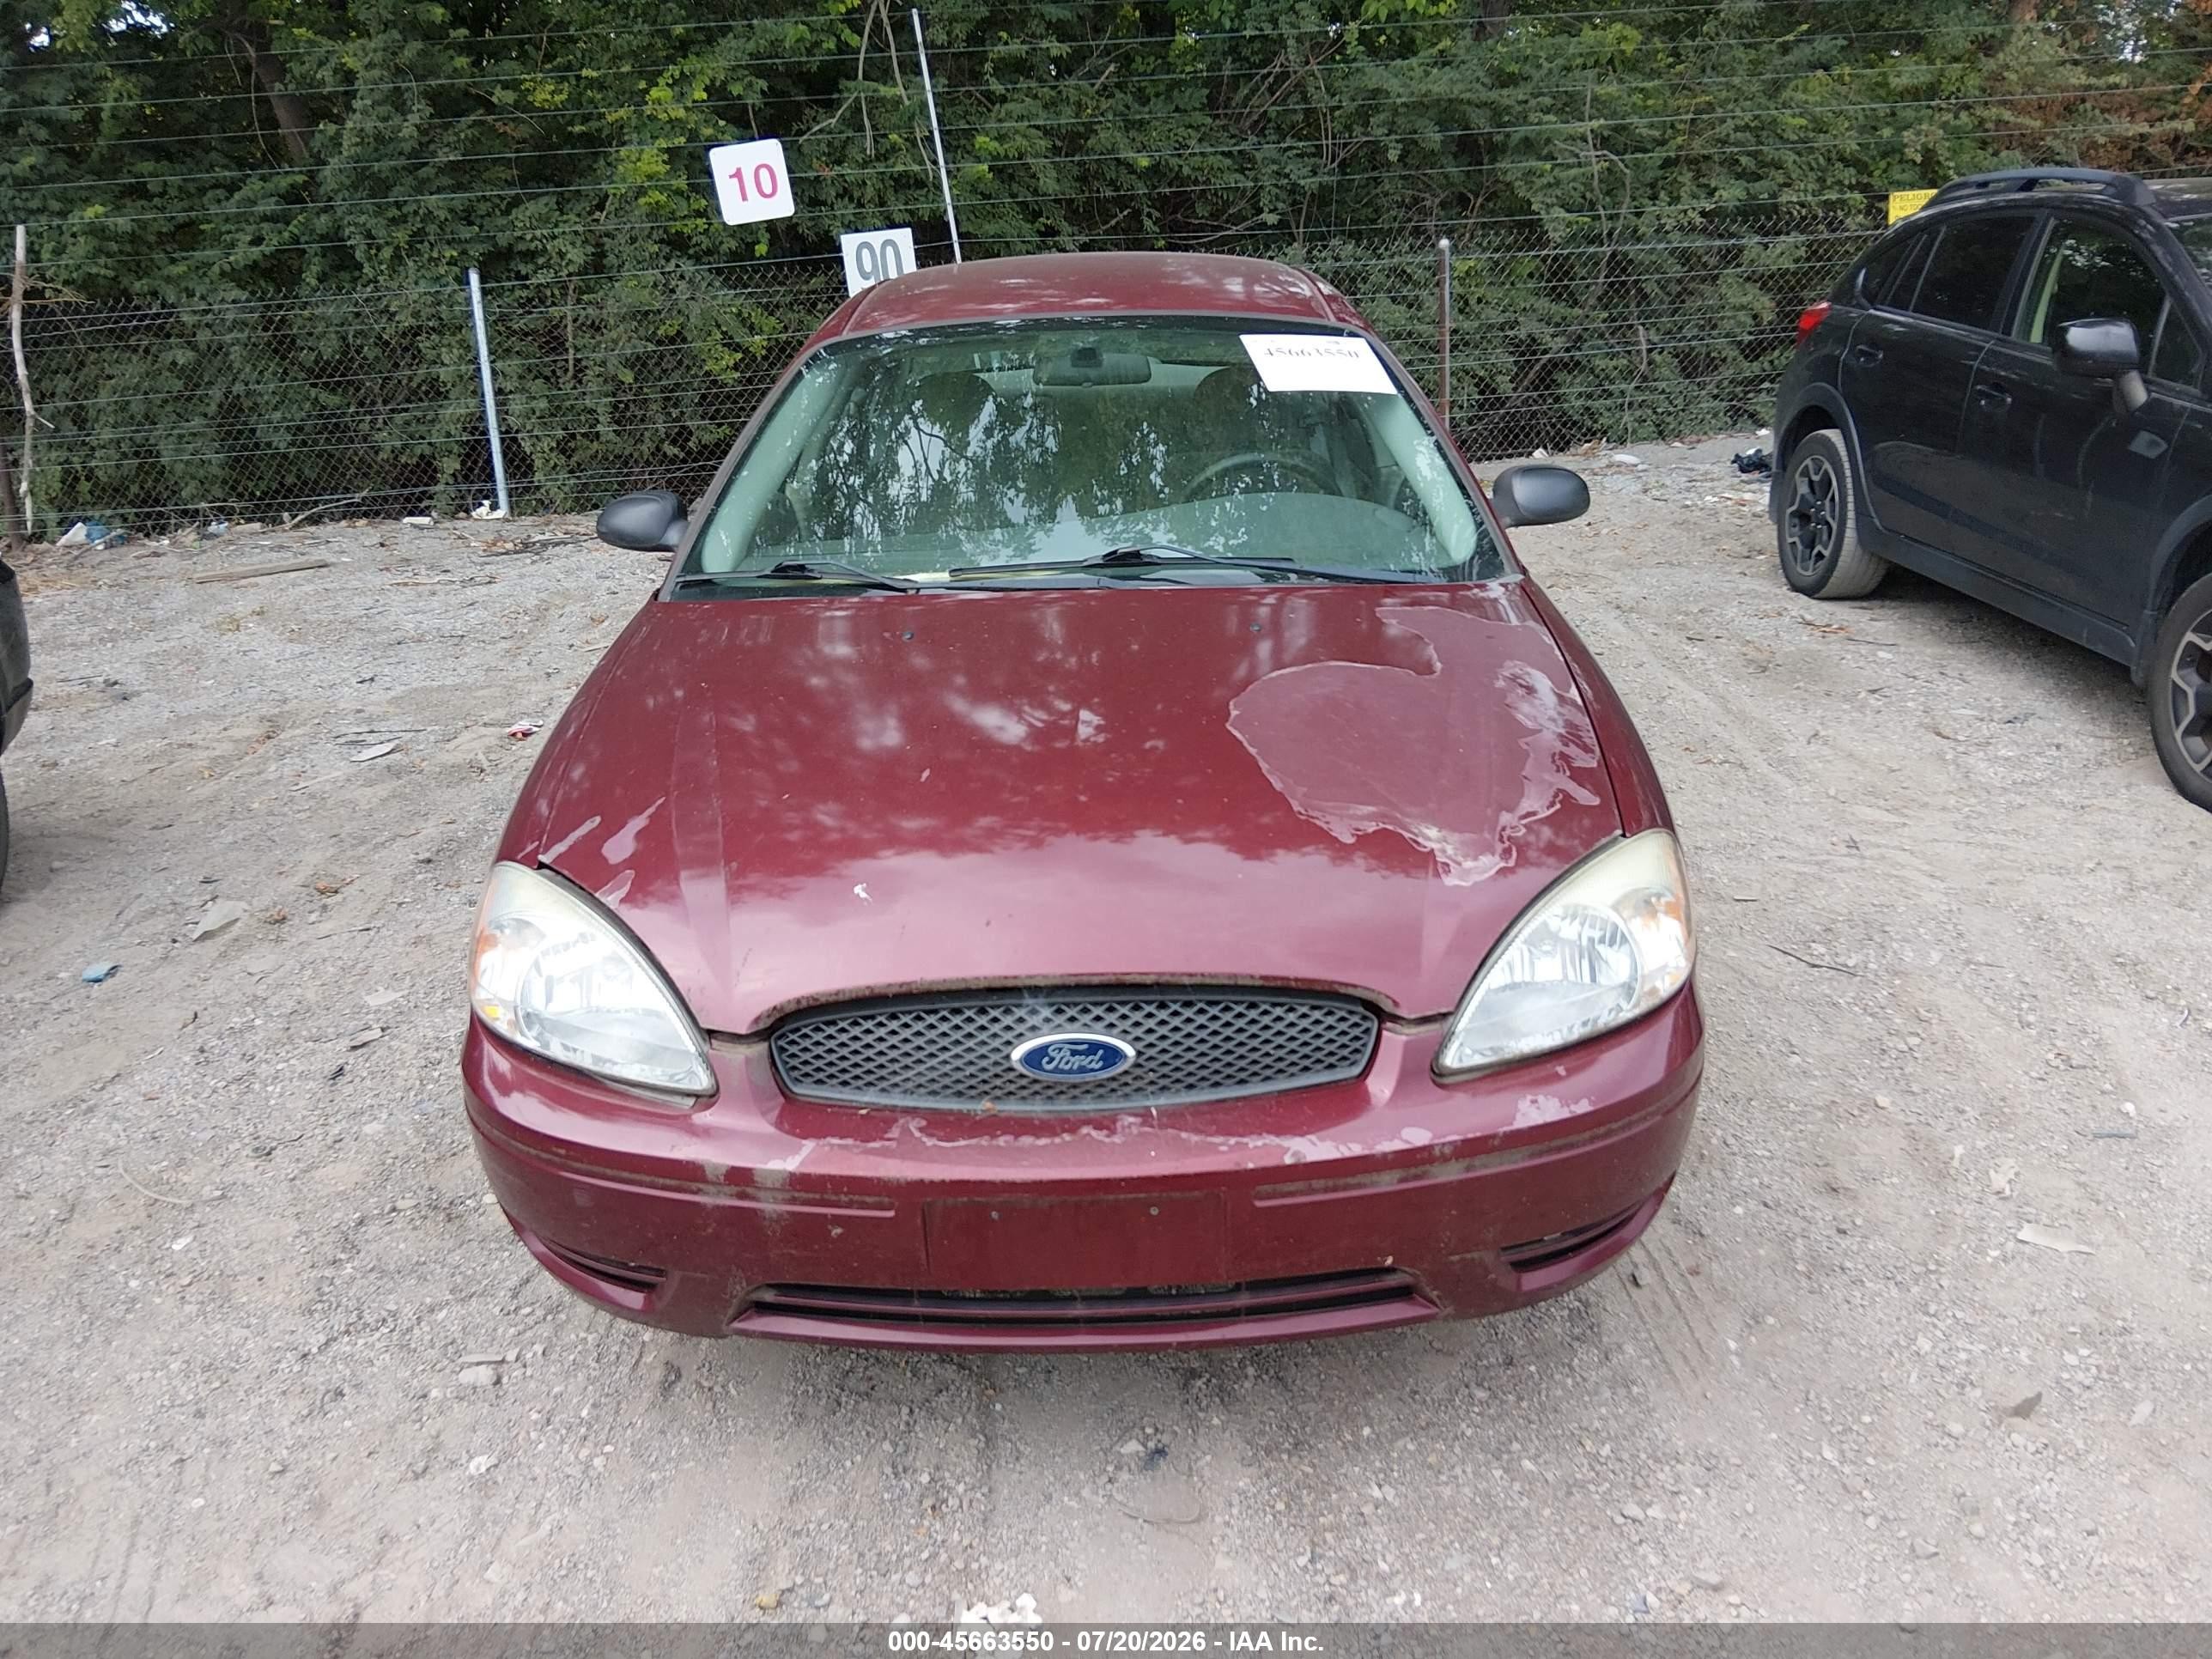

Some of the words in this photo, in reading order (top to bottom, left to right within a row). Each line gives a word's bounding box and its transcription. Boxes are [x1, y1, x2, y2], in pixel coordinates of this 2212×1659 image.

[728, 163, 779, 203] 10
[855, 239, 904, 283] 90
[1041, 1043, 1104, 1071] Ford
